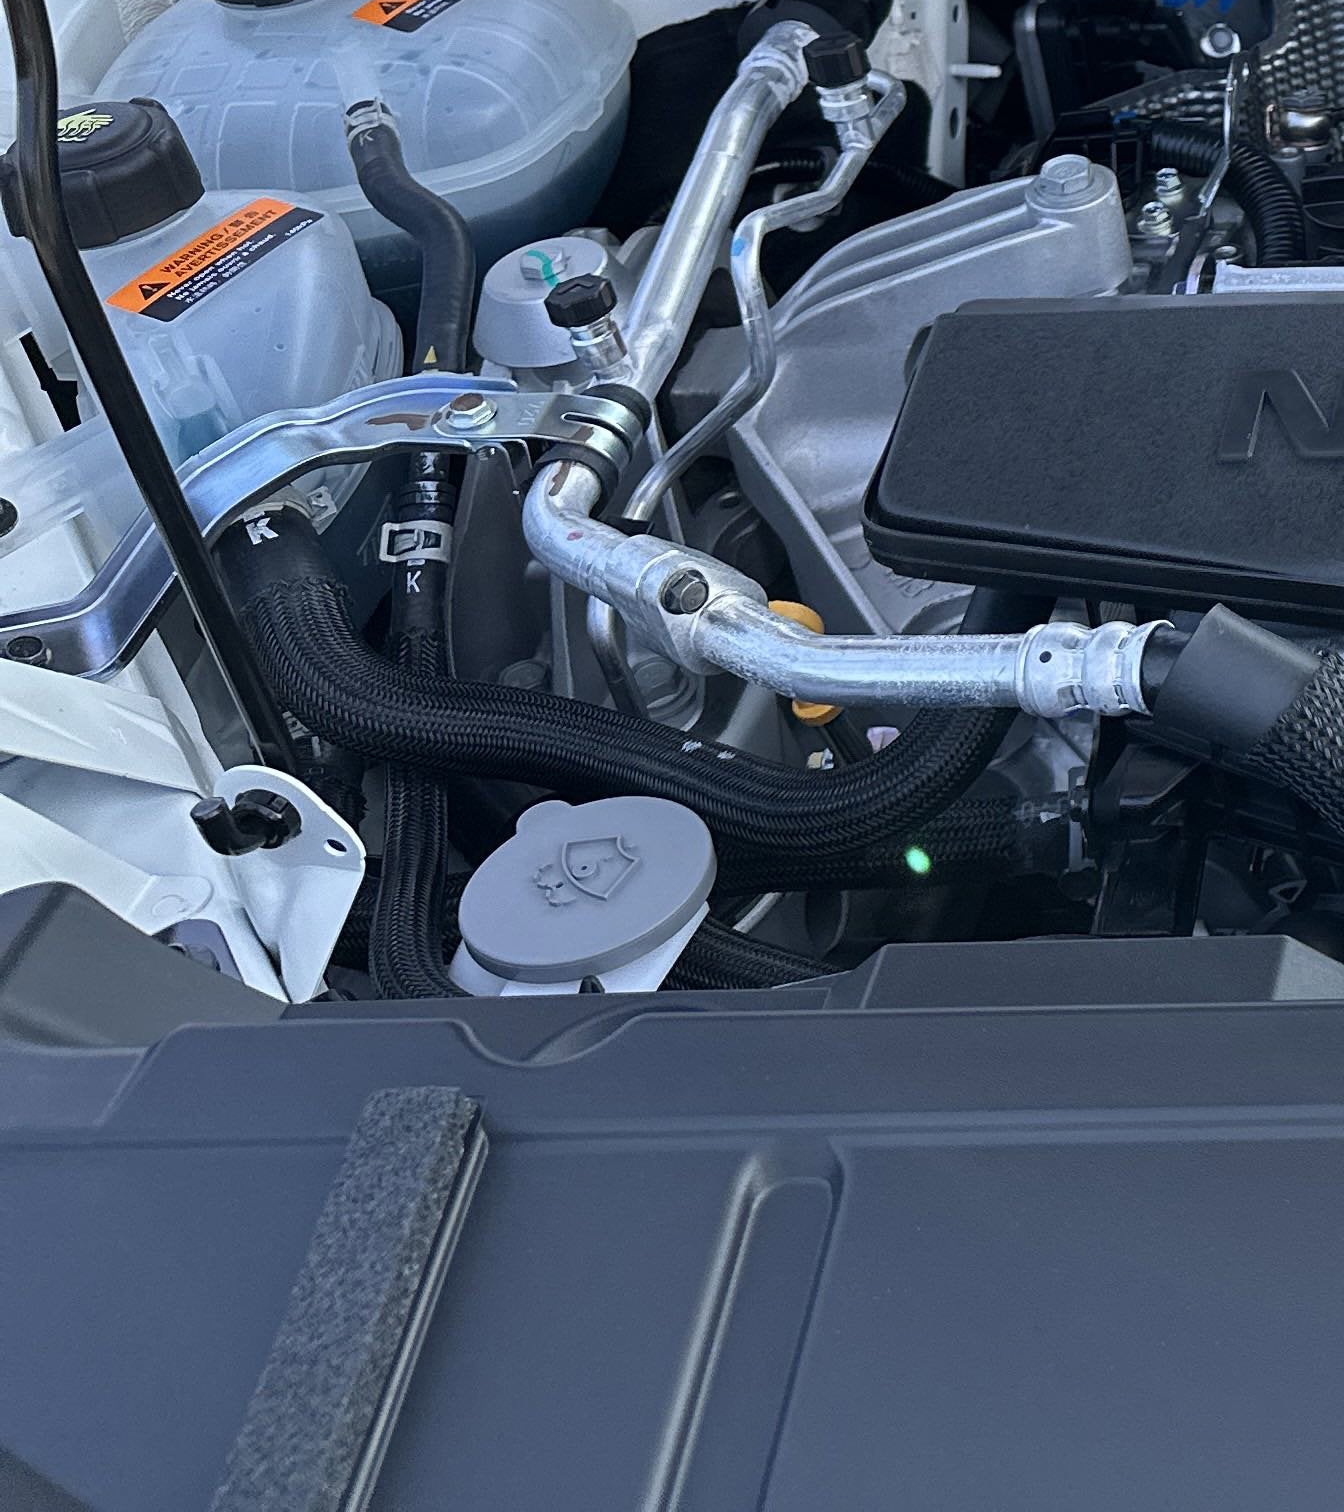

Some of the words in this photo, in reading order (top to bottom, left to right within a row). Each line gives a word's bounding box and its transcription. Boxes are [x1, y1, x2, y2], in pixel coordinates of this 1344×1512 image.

[160, 233, 224, 273] WARNING
[175, 209, 277, 277] AVERTISSEMENT
[194, 266, 215, 282] open
[215, 252, 236, 267] when
[245, 517, 280, 545] K
[405, 570, 422, 594] K
